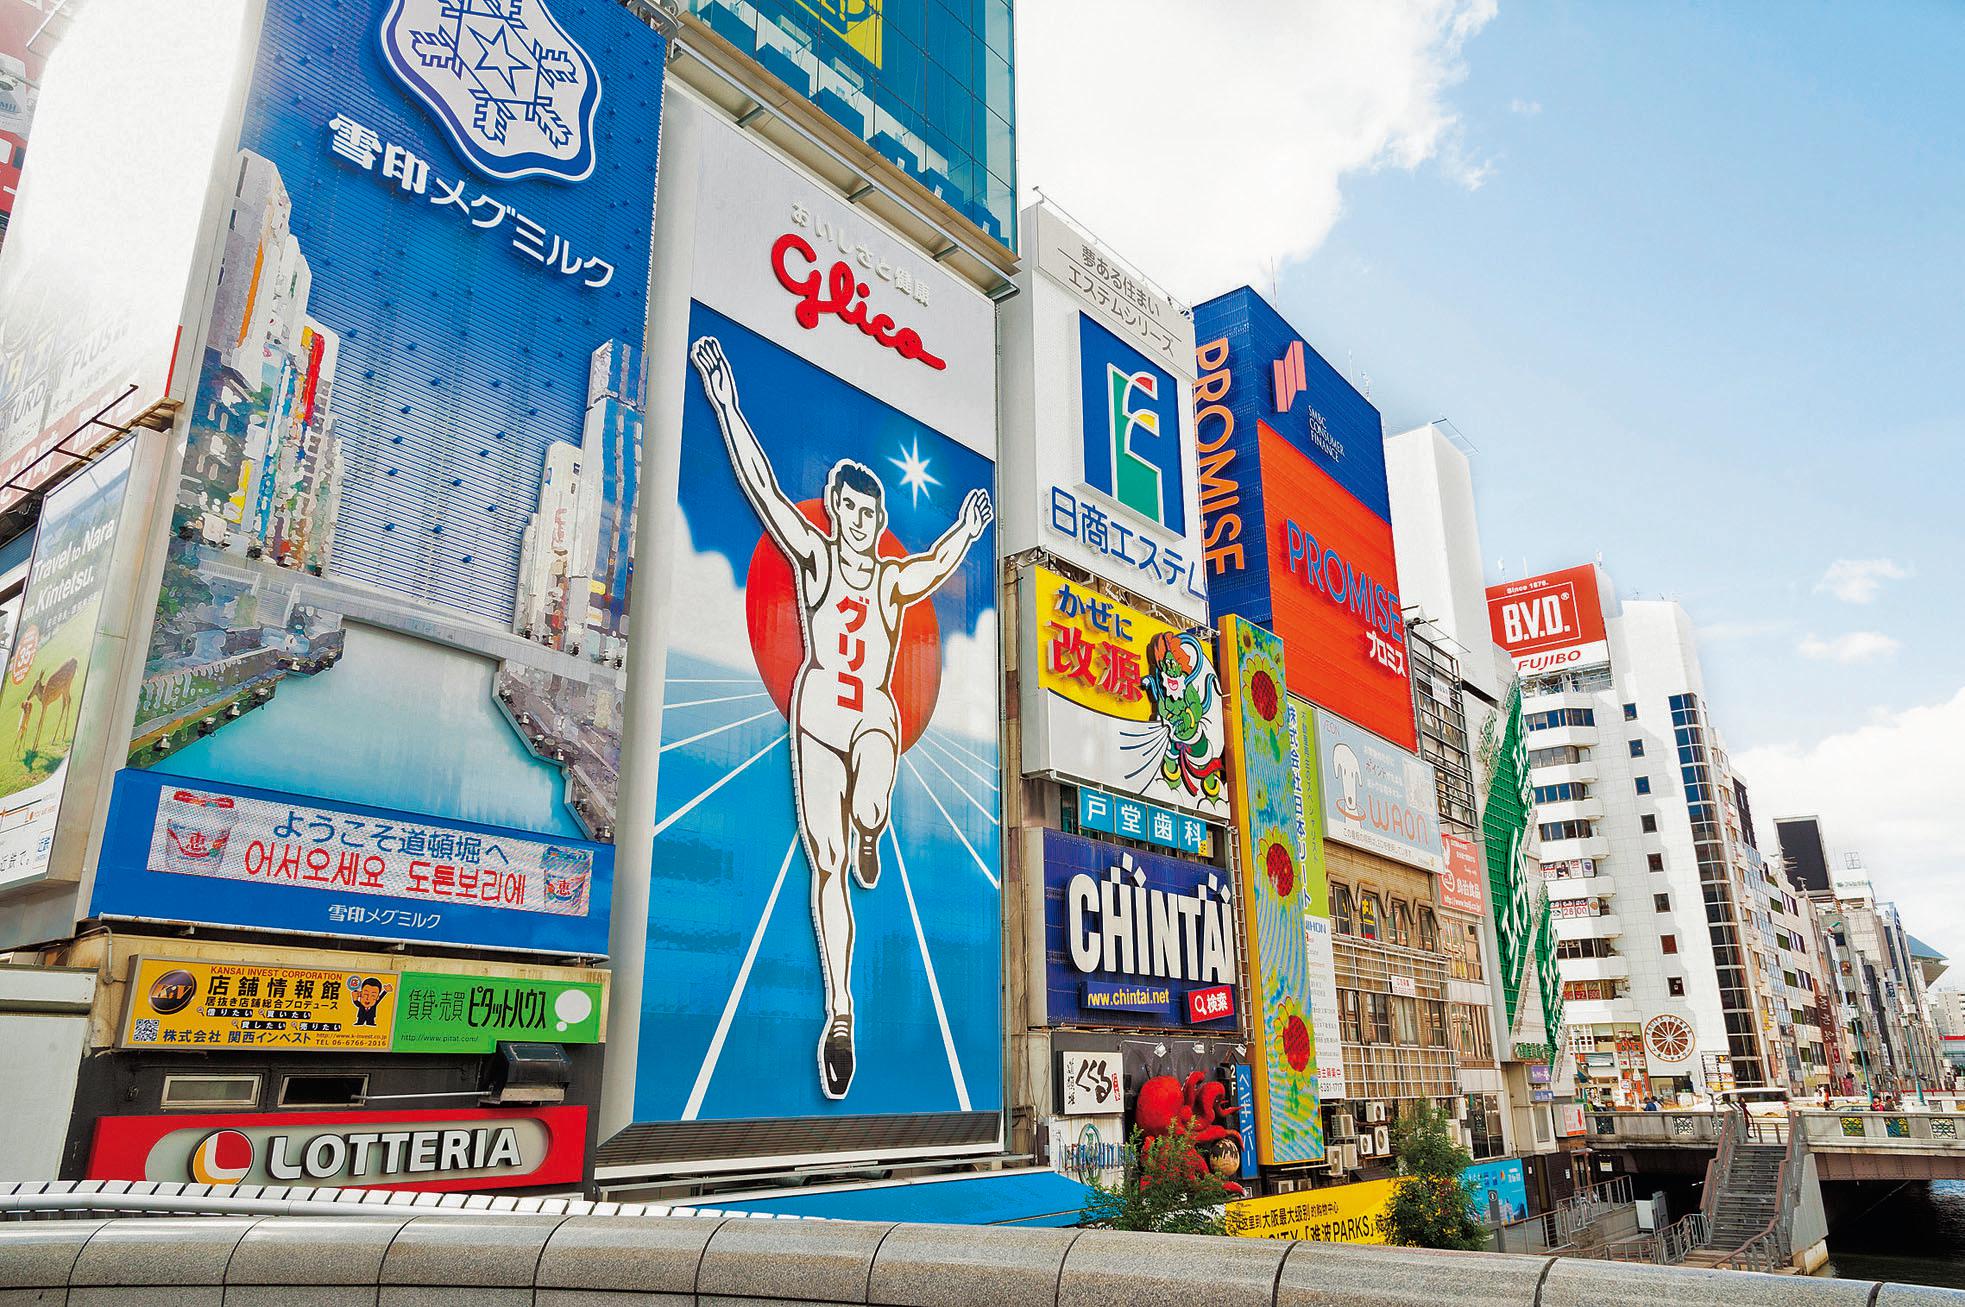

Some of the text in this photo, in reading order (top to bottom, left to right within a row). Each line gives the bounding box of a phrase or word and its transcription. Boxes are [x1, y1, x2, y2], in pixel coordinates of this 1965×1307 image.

[328, 112, 615, 288] 雪印メグミルク
[771, 233, 946, 371] Glico
[1082, 244, 1160, 317] 夢ある住まい
[1068, 265, 1174, 357] エステムシリーズ
[1308, 405, 1327, 429] SMBC
[1309, 417, 1345, 456] CONSUMER
[1194, 337, 1245, 576] PROMISE
[1310, 430, 1340, 463] FINANCE
[33, 519, 116, 586] Travel to Nara
[22, 606, 35, 622] on
[36, 565, 95, 614] Kintetsu.
[1287, 518, 1403, 644] PROMISE
[1506, 585, 1528, 595] Since
[1058, 584, 1133, 641] かぜに
[836, 596, 870, 713] グリコ
[1049, 621, 1144, 702] 改源
[1366, 630, 1407, 678] プロミス
[1518, 650, 1581, 671] FUJIBO
[273, 811, 510, 865] ようこそ道頓堀へ
[244, 840, 527, 905] 어서오세요 도톤보리에
[328, 903, 442, 930] 雪印メグミルク
[1069, 857, 1236, 984] CHINTAI
[208, 975, 342, 1001] 店舗情報館
[210, 966, 343, 980] KANSAI INVEST CORPORATION
[207, 1008, 312, 1019] 借りたい 買いたい
[241, 1021, 342, 1031] 貸したい 売りたい
[468, 986, 547, 1029] ピタットハウス
[1206, 992, 1229, 1014] 検索
[163, 1029, 311, 1045] 株式会社 関西インベスト
[266, 1127, 523, 1180] LOTTERIA
